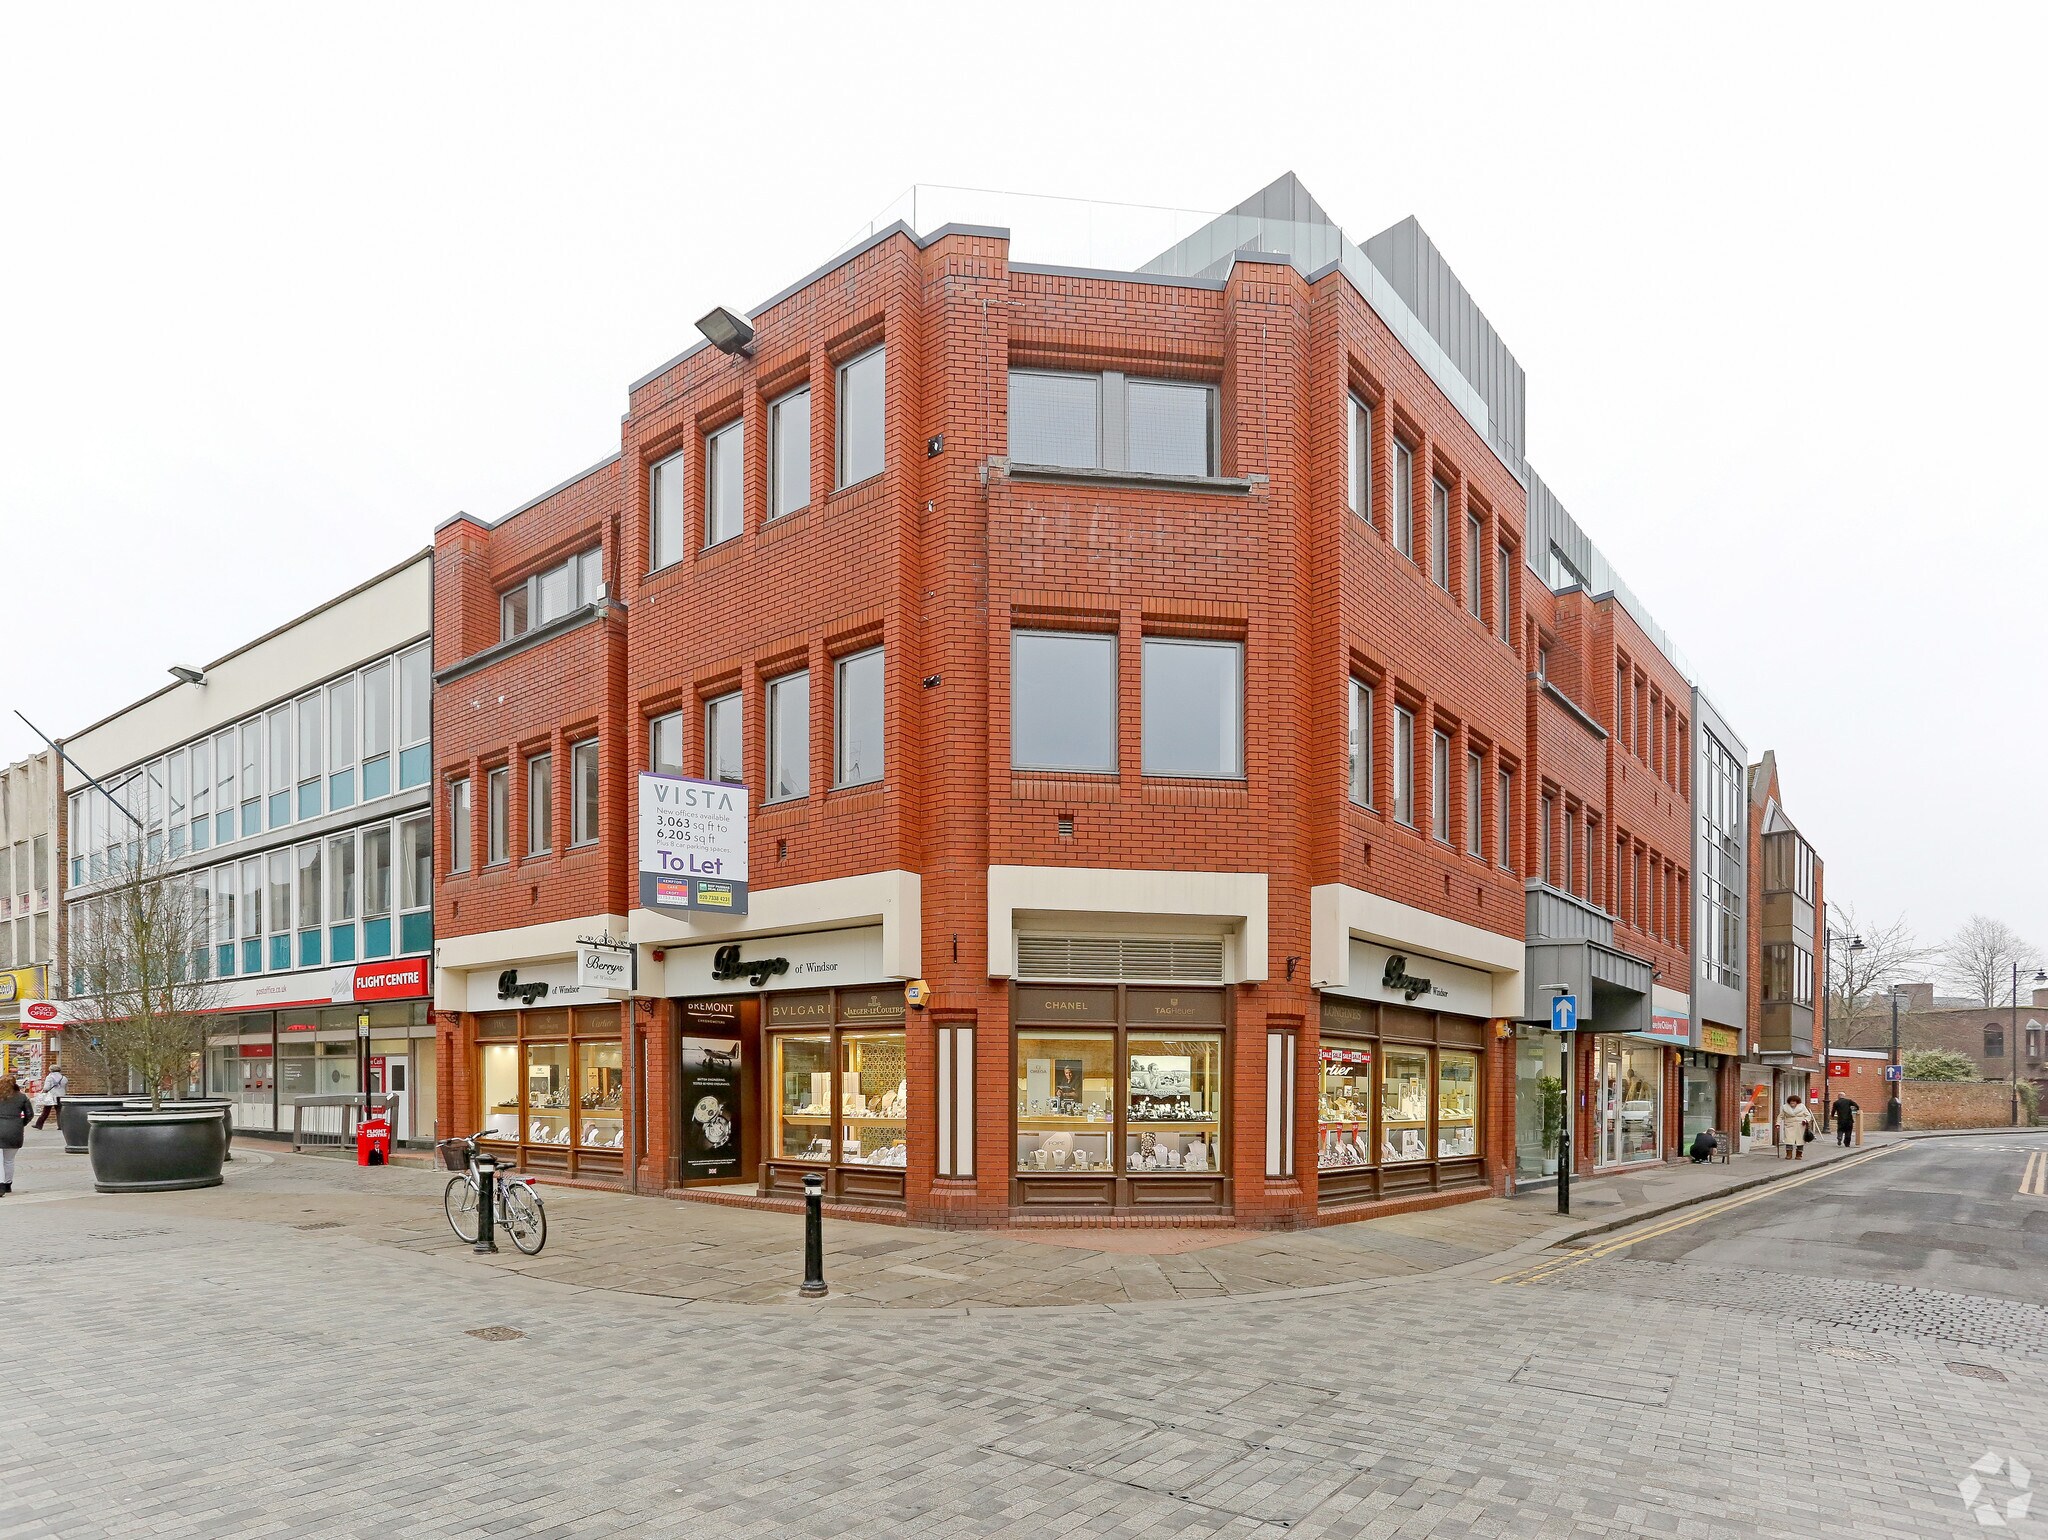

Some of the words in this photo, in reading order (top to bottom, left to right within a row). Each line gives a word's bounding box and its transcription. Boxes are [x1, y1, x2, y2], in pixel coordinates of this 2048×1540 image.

[654, 784, 733, 811] VISTA
[656, 807, 674, 815] New
[675, 809, 698, 818] offices
[699, 813, 730, 822] available
[657, 815, 690, 828] 3,063
[692, 822, 705, 833] sq
[707, 821, 714, 831] ft
[717, 823, 727, 833] to
[657, 828, 691, 841] 6,205
[693, 835, 706, 845] sq
[708, 833, 715, 844] ft
[686, 843, 709, 852] parking
[710, 846, 732, 854] spaces.
[657, 850, 684, 871] To
[689, 853, 723, 875] Let
[586, 955, 625, 975] Berrys
[794, 963, 803, 974] of
[806, 961, 838, 973] Windsor
[356, 974, 386, 989] FLIGHT
[386, 971, 419, 986] CENTRE
[256, 985, 287, 996] postoffice.co.uk
[551, 986, 558, 995] of
[558, 985, 580, 995] Windsor
[1432, 986, 1448, 998] Windsor
[772, 1004, 831, 1016] BVLGARI
[1045, 1001, 1088, 1010] CHANEL
[1324, 1004, 1362, 1021] LONGINES
